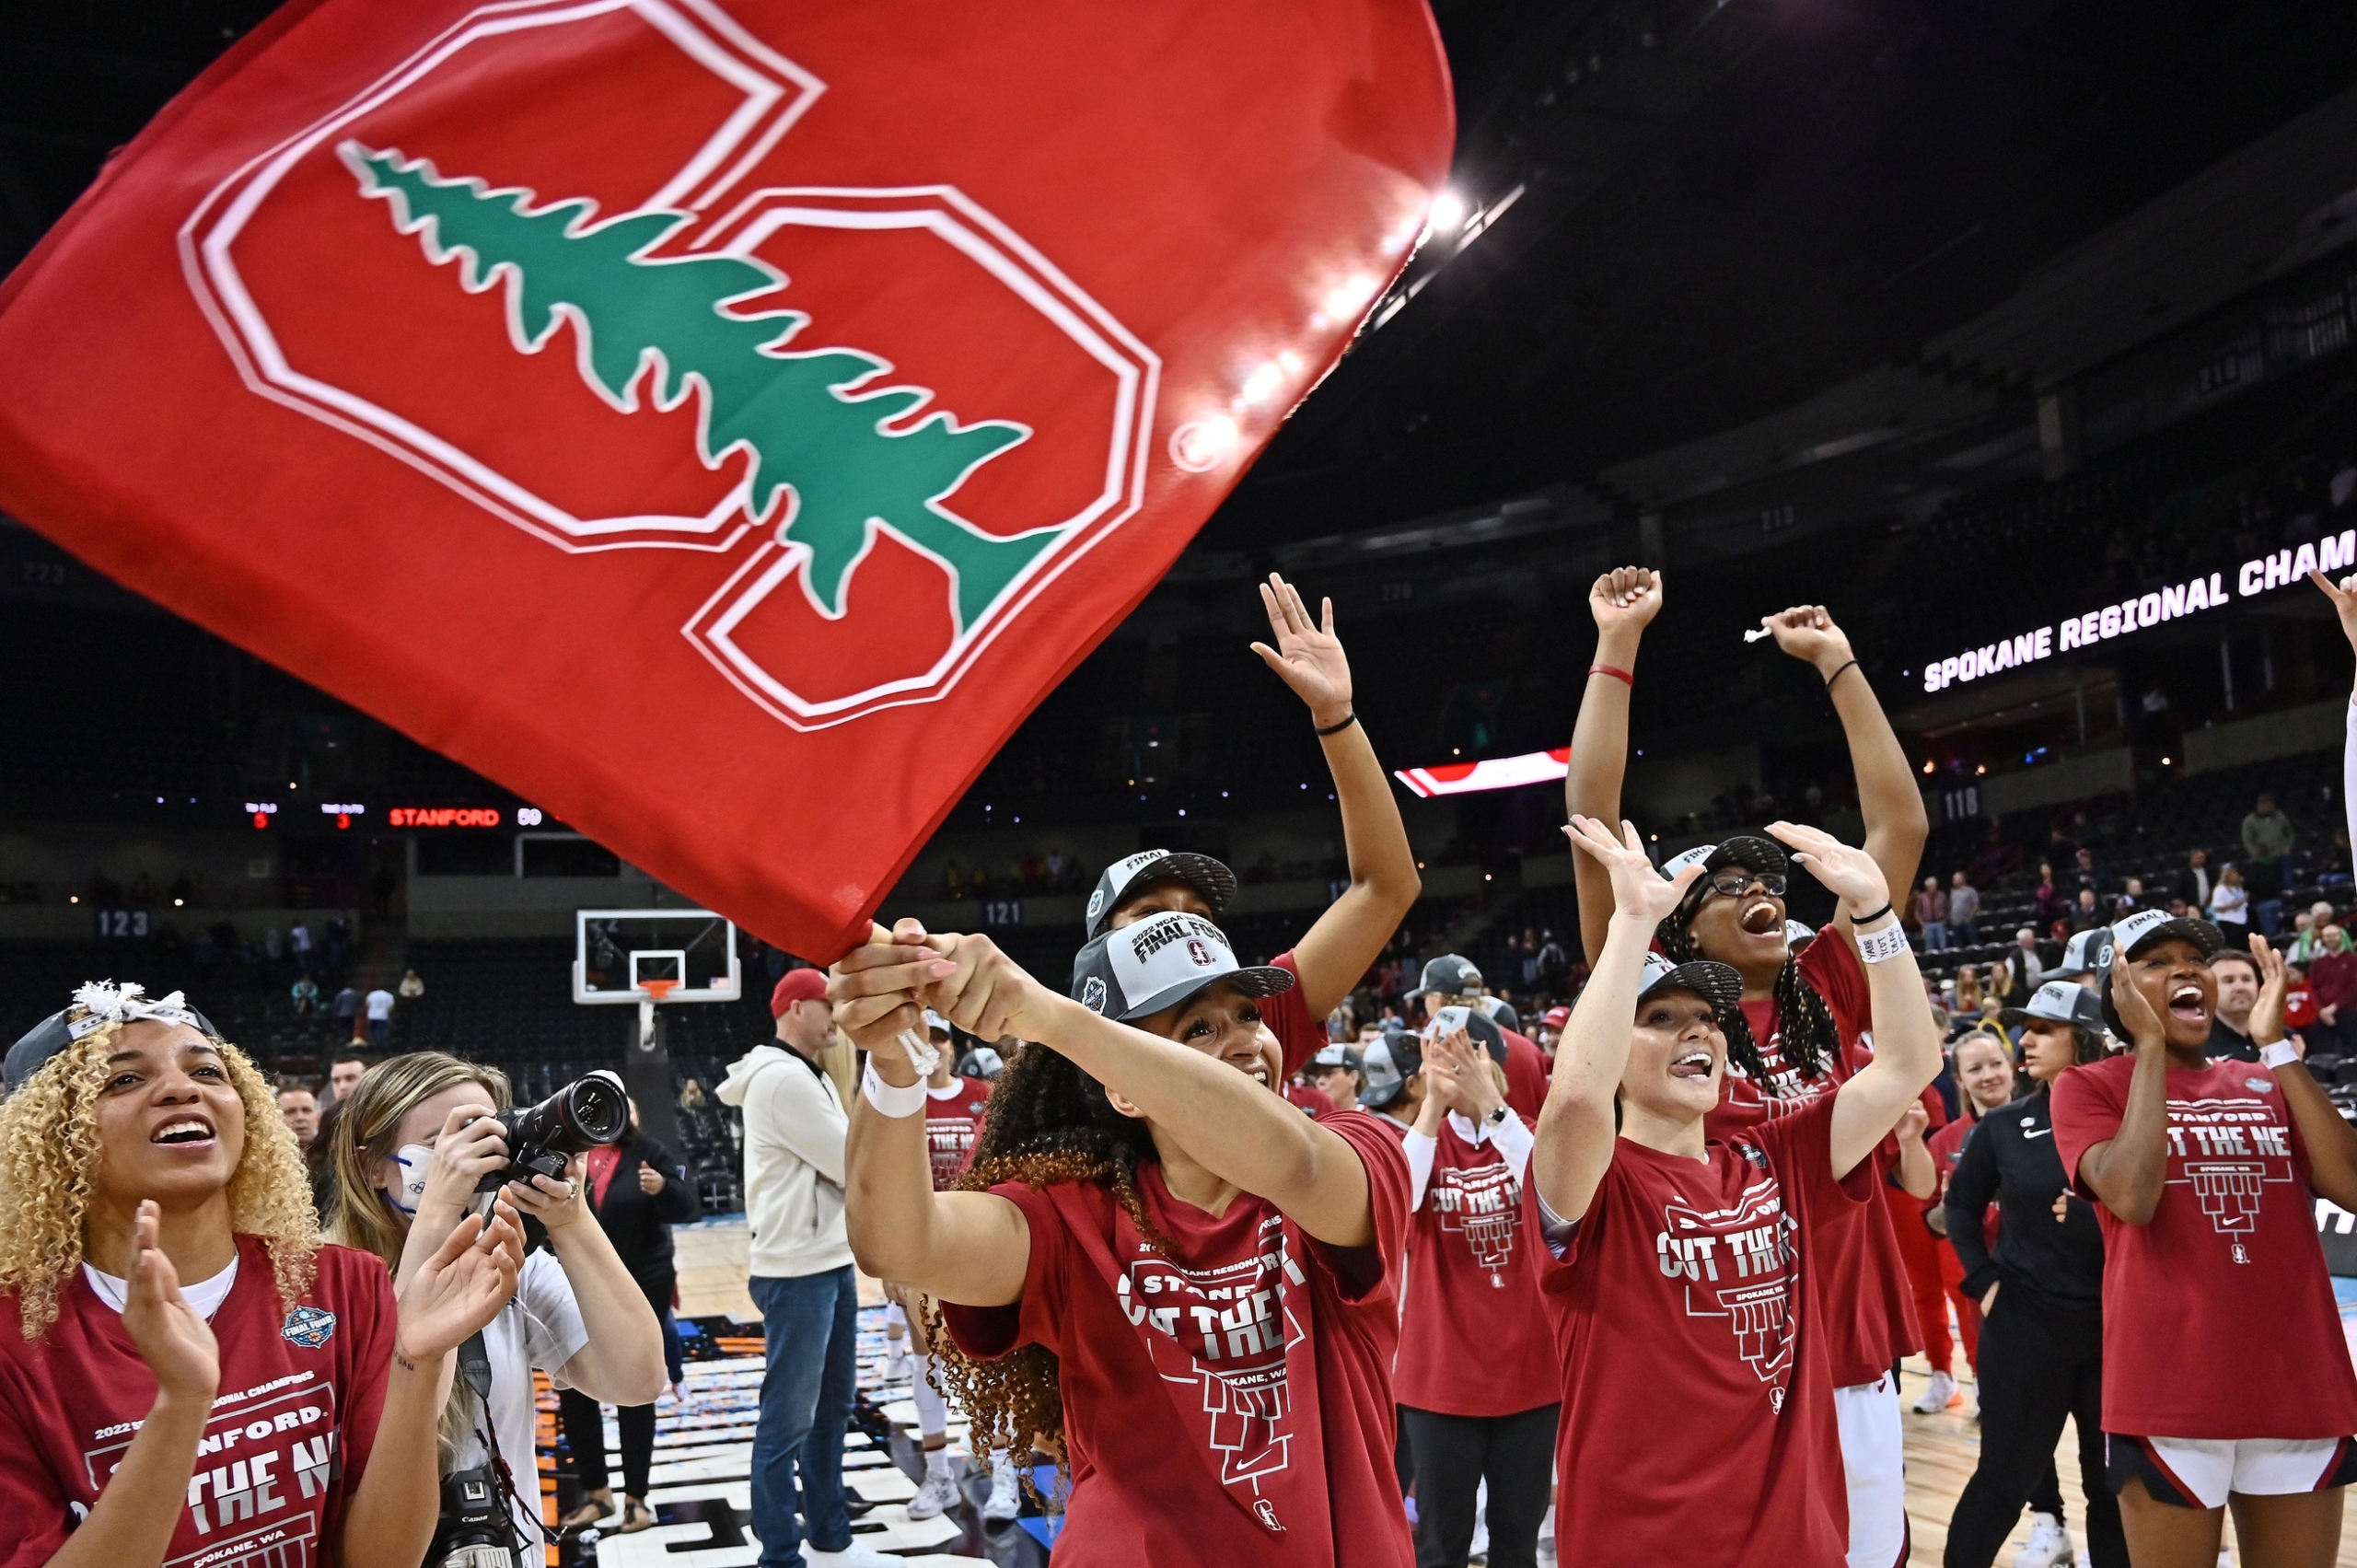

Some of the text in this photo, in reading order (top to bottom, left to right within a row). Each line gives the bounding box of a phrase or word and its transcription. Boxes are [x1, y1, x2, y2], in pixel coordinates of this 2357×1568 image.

[1924, 627, 2052, 692] SPOKANE
[2059, 573, 2229, 652] REGIONAL
[389, 807, 501, 827] STANFORD
[1944, 786, 1978, 820] 118
[99, 910, 148, 936] 123
[987, 901, 1020, 924] 121
[1132, 925, 1155, 946] 2022
[1155, 914, 1184, 929] NCAA
[1133, 922, 1192, 965] FINAL
[2189, 1126, 2252, 1156] THE
[1430, 1187, 1464, 1212] CUT
[1465, 1186, 1504, 1214] THE
[1213, 1256, 1260, 1275] REGIONA
[1724, 1225, 1779, 1278] THE
[285, 1315, 332, 1337] FINAL FOUR
[1190, 1287, 1285, 1361] THE
[95, 1423, 132, 1441] 2022
[197, 1405, 322, 1457] NFORD
[187, 1449, 287, 1536] THE
[462, 1515, 488, 1523] Canon
[193, 1529, 286, 1568] SPOKANE, WA
